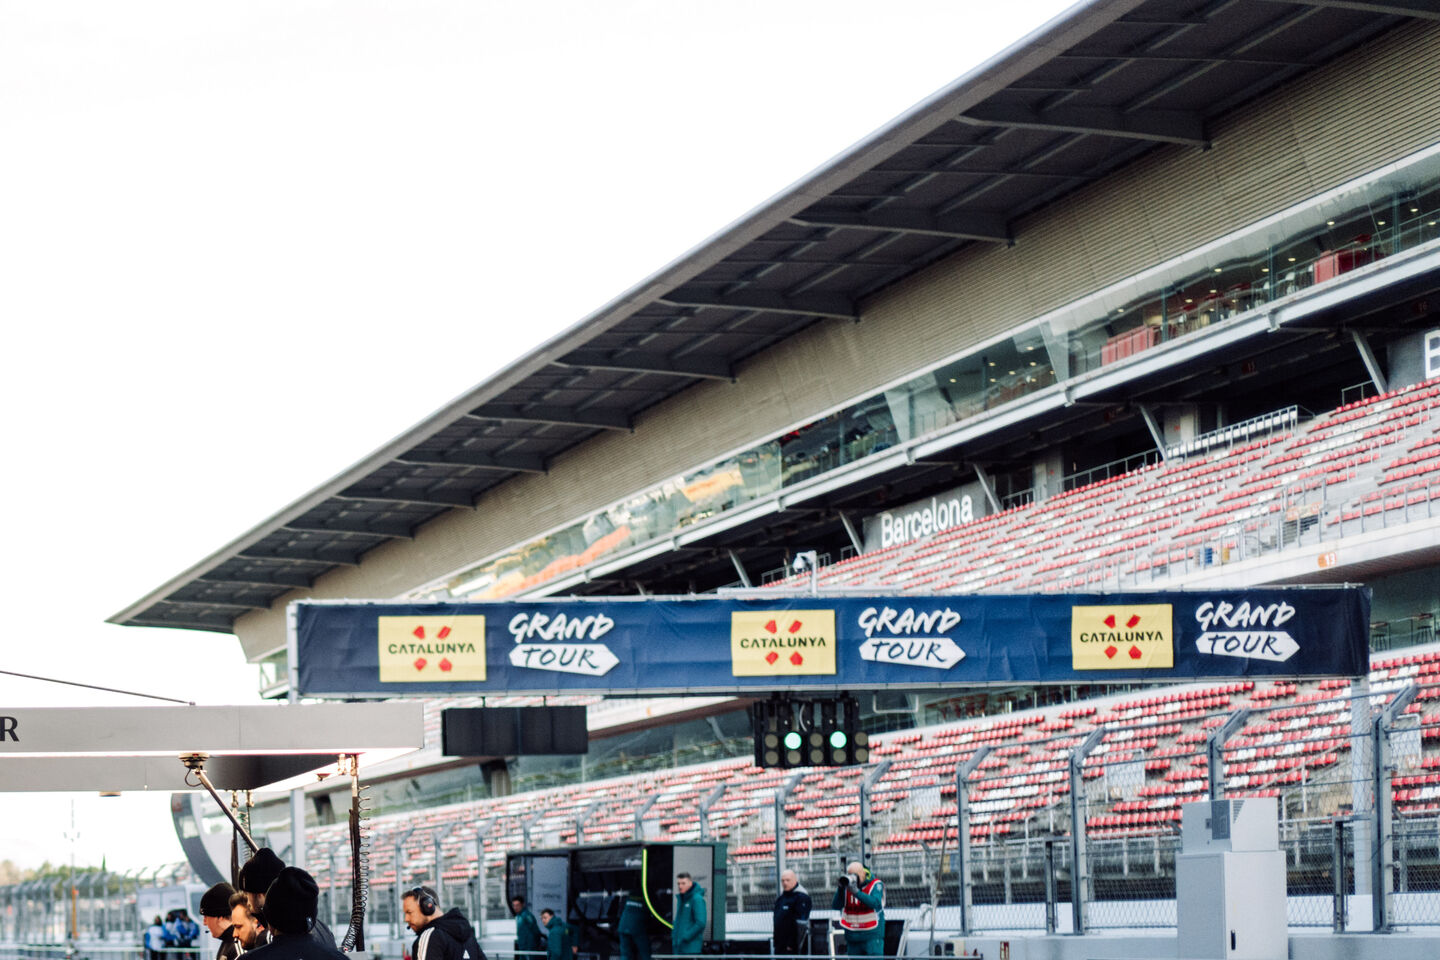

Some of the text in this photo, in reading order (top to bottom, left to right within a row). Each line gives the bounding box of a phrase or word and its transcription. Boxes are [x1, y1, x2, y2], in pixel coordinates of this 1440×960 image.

[881, 495, 973, 548] Barcelona
[858, 606, 961, 637] GRAND
[1195, 601, 1295, 631] GRAND
[509, 612, 614, 643] GRAND
[1080, 631, 1163, 643] CATALUNYA
[388, 643, 475, 655] CATALUNYA
[740, 637, 826, 648] CATALUNYA
[871, 641, 947, 663] TOUR
[1208, 634, 1283, 656] TOUR
[522, 648, 600, 669] TOUR
